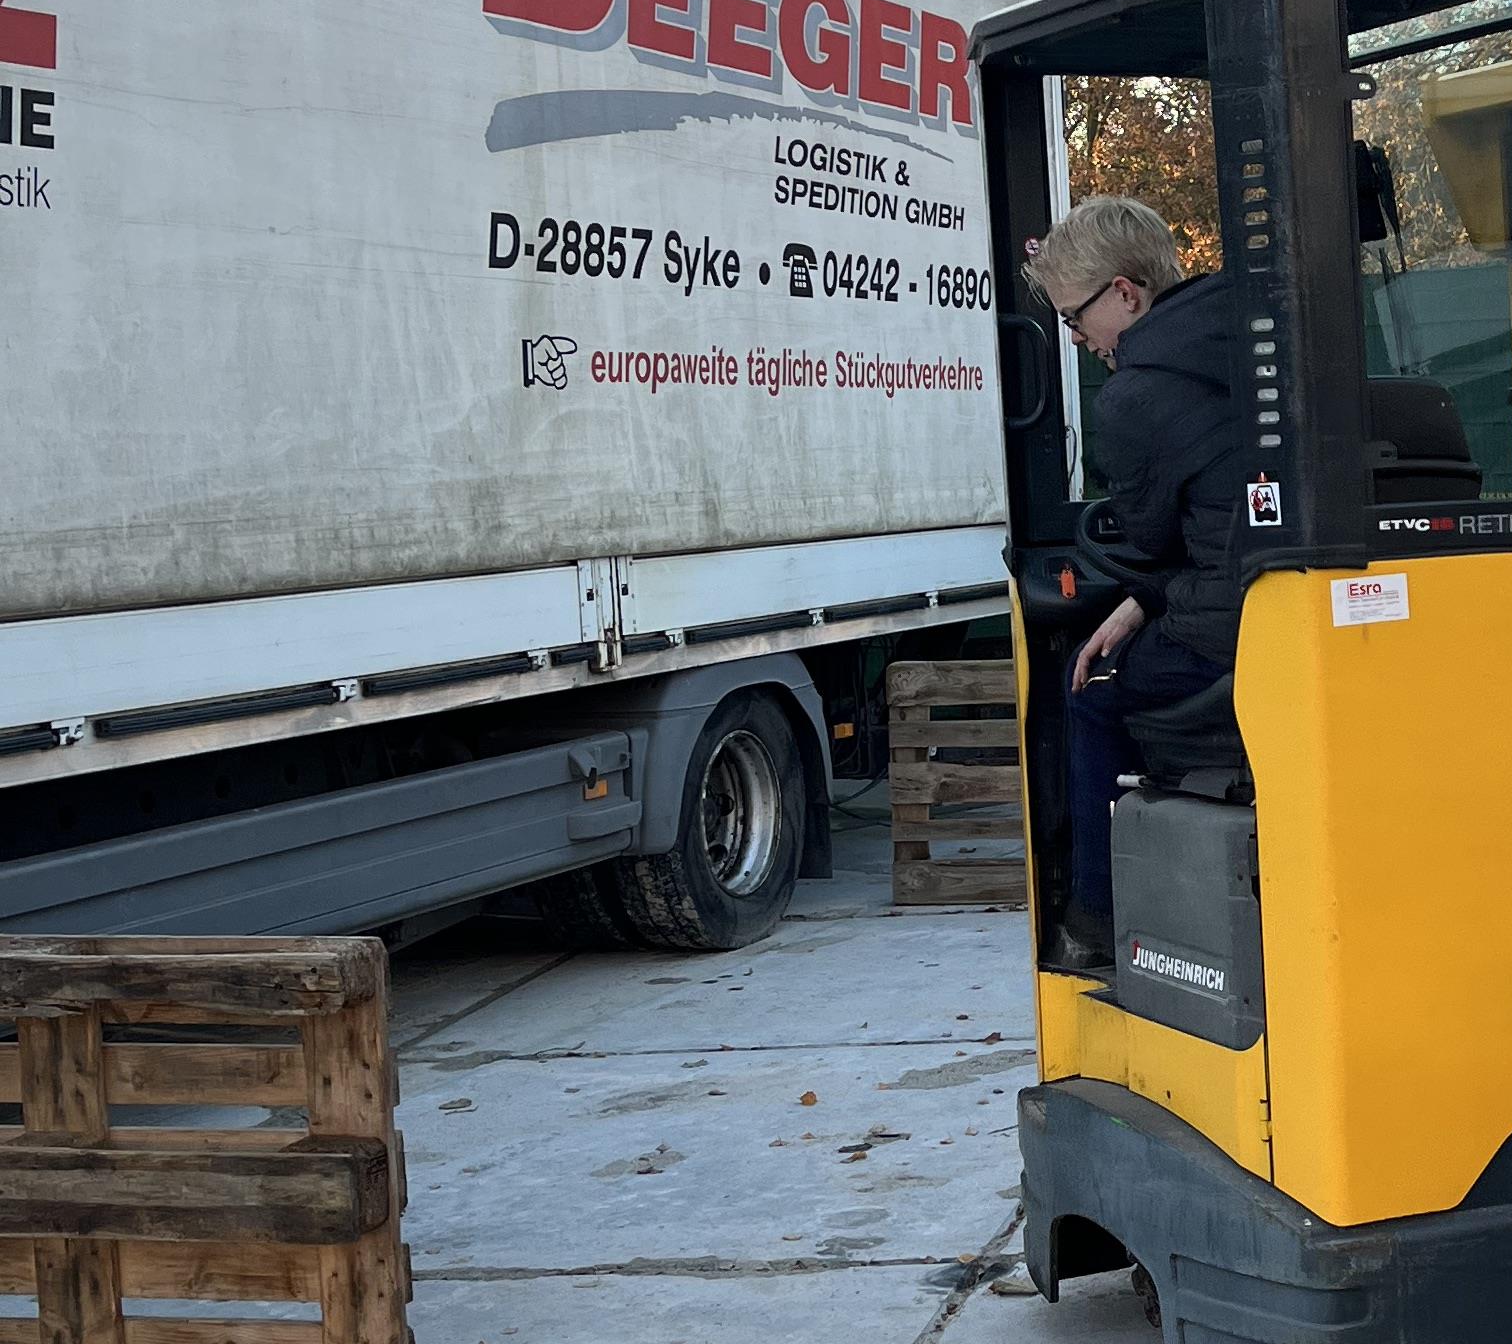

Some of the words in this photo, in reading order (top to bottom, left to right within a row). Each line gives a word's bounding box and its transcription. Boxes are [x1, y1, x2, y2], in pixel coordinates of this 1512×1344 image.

[774, 135, 888, 183] LOGISTIK
[894, 160, 910, 187] &
[774, 175, 898, 221] SPEDITION
[905, 197, 965, 232] GMBH
[488, 212, 653, 279] D-28857
[663, 230, 740, 297] Syke
[822, 250, 900, 302] 04242
[926, 263, 992, 311] 16890
[591, 345, 739, 394] europaweite
[746, 347, 828, 397] tägliche
[834, 350, 984, 398] Stückgutverkehre
[1349, 583, 1382, 597] Esra
[1132, 946, 1226, 991] JUNGHEINRICH
